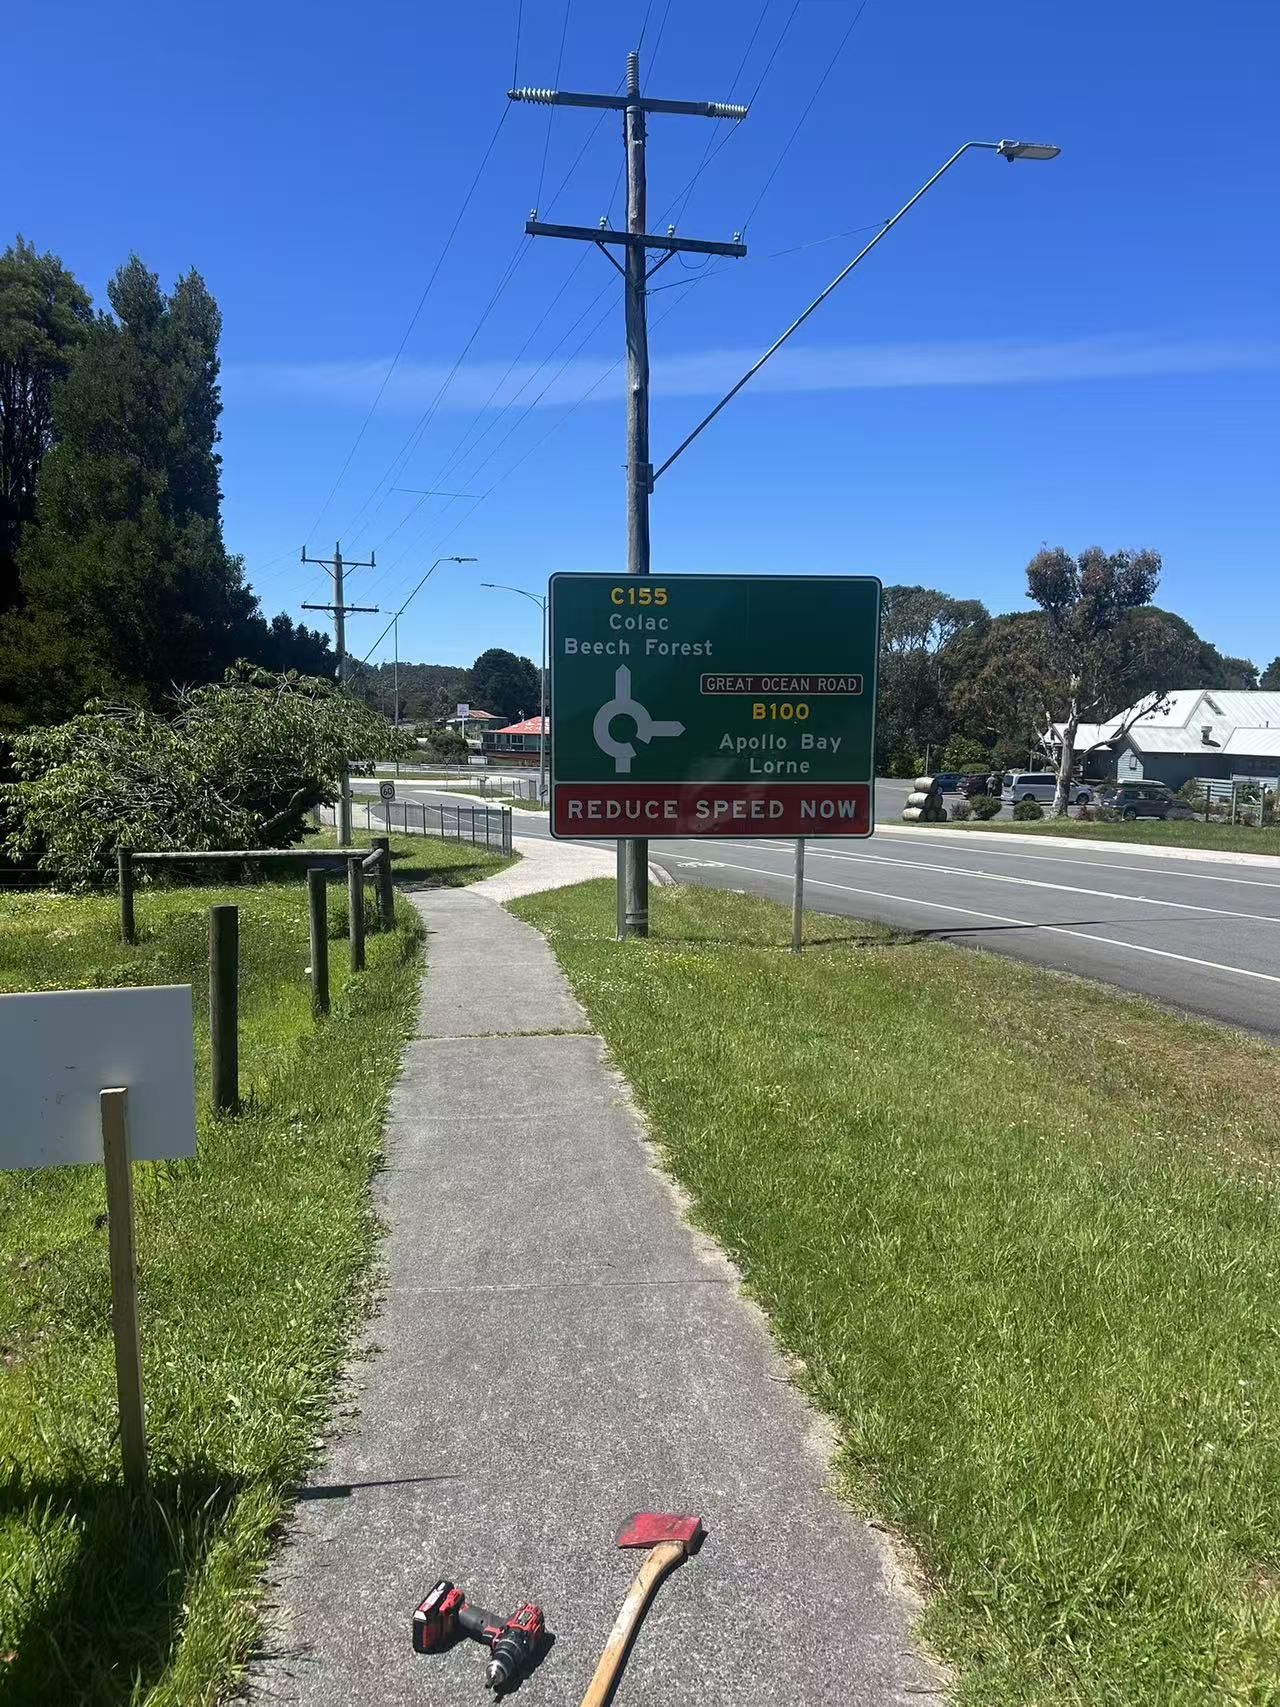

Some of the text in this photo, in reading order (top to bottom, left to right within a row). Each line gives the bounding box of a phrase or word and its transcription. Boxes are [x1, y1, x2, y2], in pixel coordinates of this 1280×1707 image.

[611, 588, 668, 606] C155
[609, 614, 669, 631] Colac
[564, 638, 713, 656] Beech Forest
[706, 677, 857, 691] GREAT OCEAN ROAD
[753, 704, 810, 720] B100
[719, 733, 841, 753] Apollo Bay
[750, 758, 810, 774] Lorne
[568, 800, 856, 818] REDUCE SPEED NOW
